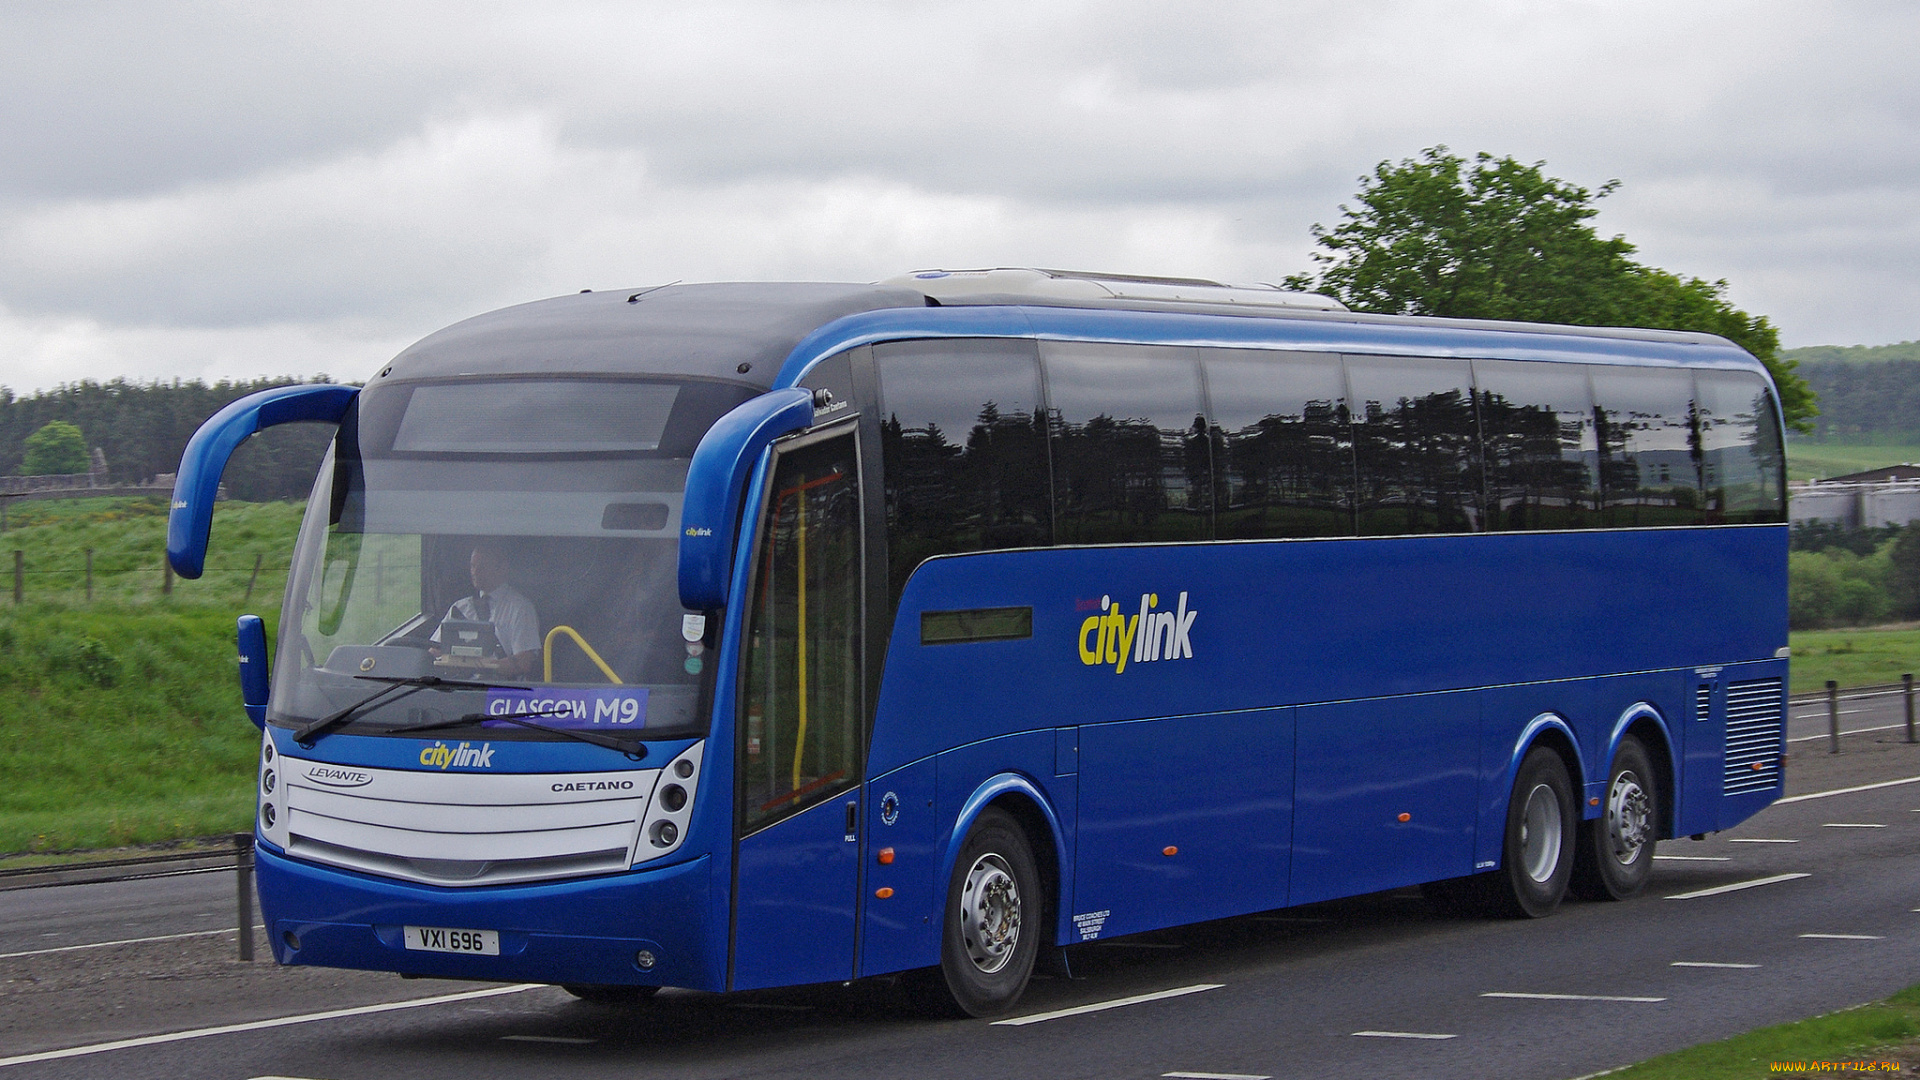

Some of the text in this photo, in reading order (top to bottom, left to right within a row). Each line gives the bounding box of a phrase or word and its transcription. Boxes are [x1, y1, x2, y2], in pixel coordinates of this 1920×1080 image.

[1078, 591, 1198, 675] citylink
[593, 698, 639, 724] M9
[420, 741, 496, 770] citylink
[309, 767, 368, 783] LEVANTE
[551, 780, 634, 792] CAETANO
[420, 928, 483, 951] VXI 696
